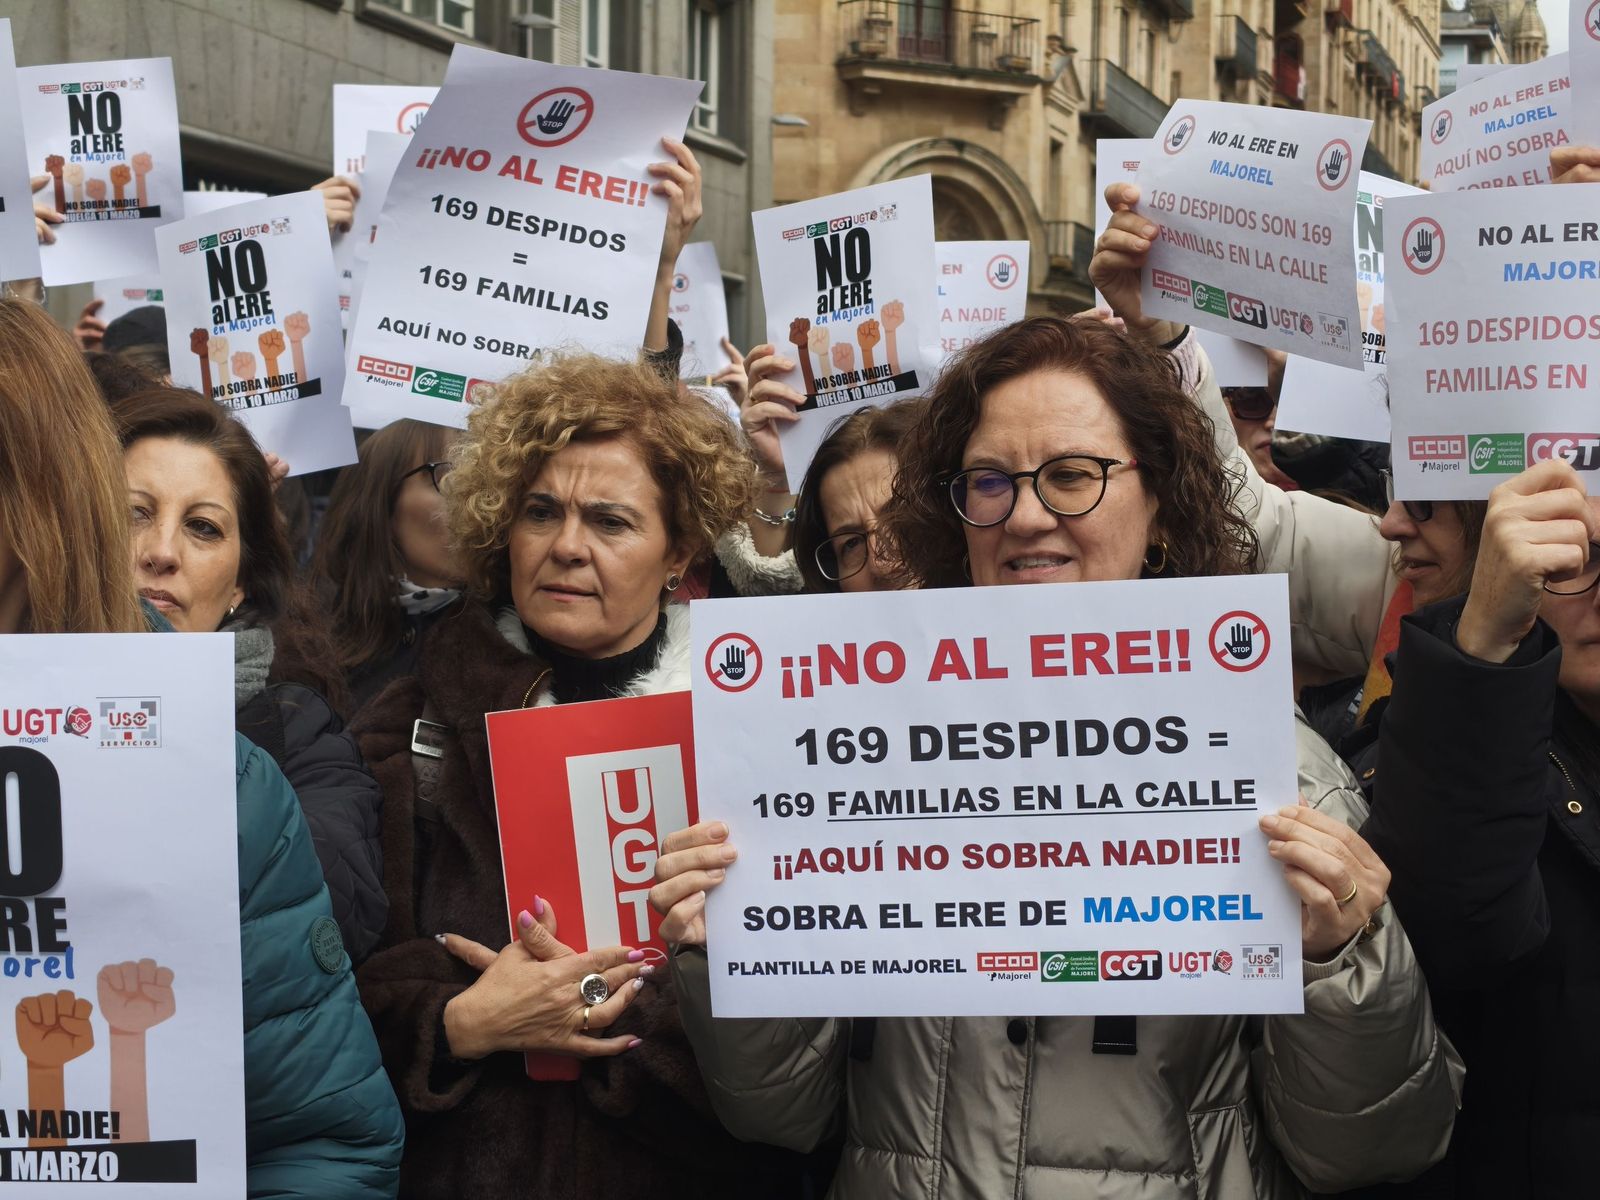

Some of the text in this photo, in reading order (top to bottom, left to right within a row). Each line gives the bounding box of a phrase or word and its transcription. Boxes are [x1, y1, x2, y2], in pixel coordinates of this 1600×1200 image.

[1469, 77, 1571, 116] NO AL ERE EN
[68, 91, 122, 136] NO
[542, 120, 563, 129] STOP
[1485, 105, 1557, 134] MAJOREL
[71, 133, 124, 154] al ERE
[86, 152, 125, 164] Majorel
[1208, 131, 1299, 159] NO AL ERE EN
[1434, 128, 1570, 178] AQUÍ NO SOBRA
[416, 146, 650, 207] ¡¡NO AL ERE!!
[1209, 160, 1274, 186] MAJOREL
[80, 200, 109, 209] SOBRA
[110, 210, 140, 219] MARZO
[1149, 190, 1332, 246] 169 DESPIDOS SON 169
[220, 230, 241, 243] CGT
[243, 225, 260, 237] UGT
[431, 194, 627, 253] 169 DESPIDOS
[831, 217, 852, 231] CGT
[854, 212, 870, 224] UGT
[1357, 203, 1384, 252] N
[1478, 222, 1600, 247] NO AL ER
[813, 227, 872, 292] NO
[1159, 224, 1328, 284] FAMILIAS EN LA CALLE
[205, 239, 267, 301] NO
[1503, 260, 1600, 282] MAJOR
[419, 265, 610, 320] 169 FAMILIAS
[817, 280, 873, 315] al ERE
[1155, 274, 1189, 292] CCOO
[1229, 298, 1264, 325] CGT
[1270, 306, 1299, 331] UGT
[212, 291, 274, 325] al ERE
[816, 302, 875, 325] en Majorel
[958, 308, 1006, 321] NADIE
[214, 312, 276, 335] en Majorel
[377, 317, 432, 340] AQUÍ
[437, 328, 467, 346] NO
[1419, 314, 1600, 346] 169 DESPIDOS
[360, 358, 410, 378] CCOO
[374, 376, 404, 388] Majorel
[829, 371, 861, 388] SOBRA
[861, 364, 892, 381] NADIE!
[1426, 364, 1587, 393] FAMILIAS EN
[228, 379, 262, 395] SOBRA
[264, 372, 298, 388] NADIE!
[249, 388, 299, 408] 10 MARZO
[815, 380, 896, 408] HUELGA 10 MARZO
[1412, 440, 1462, 455] CCOO
[1532, 438, 1600, 467] CGT
[1429, 462, 1460, 472] Majorel
[781, 628, 1192, 699] ¡¡NO AL ERE!!
[1232, 646, 1250, 654] STOP
[3, 708, 147, 736] UGT USO
[19, 736, 49, 744] majorel
[795, 716, 1229, 765] 169 DESPIDOS =
[753, 779, 1257, 818] 169 FAMILIAS EN LA CALLE
[0, 745, 64, 897] O
[603, 768, 659, 942] UGT
[773, 837, 1242, 881] ¡¡AQUÍ NO SOBRA NADIE!!
[0, 897, 70, 952] RE
[743, 894, 1263, 931] SOBRA EL ERE DE MAJOREL
[3, 946, 75, 979] orel
[728, 958, 967, 977] PLANTILLA DE MAJOREL
[981, 956, 1034, 968] CCOO
[1105, 955, 1158, 978] CGT
[1169, 952, 1212, 972] UGT
[1248, 954, 1274, 965] USO
[998, 972, 1031, 981] Majorel
[17, 1109, 120, 1139] NADIE!
[11, 1151, 118, 1181] MARZO
